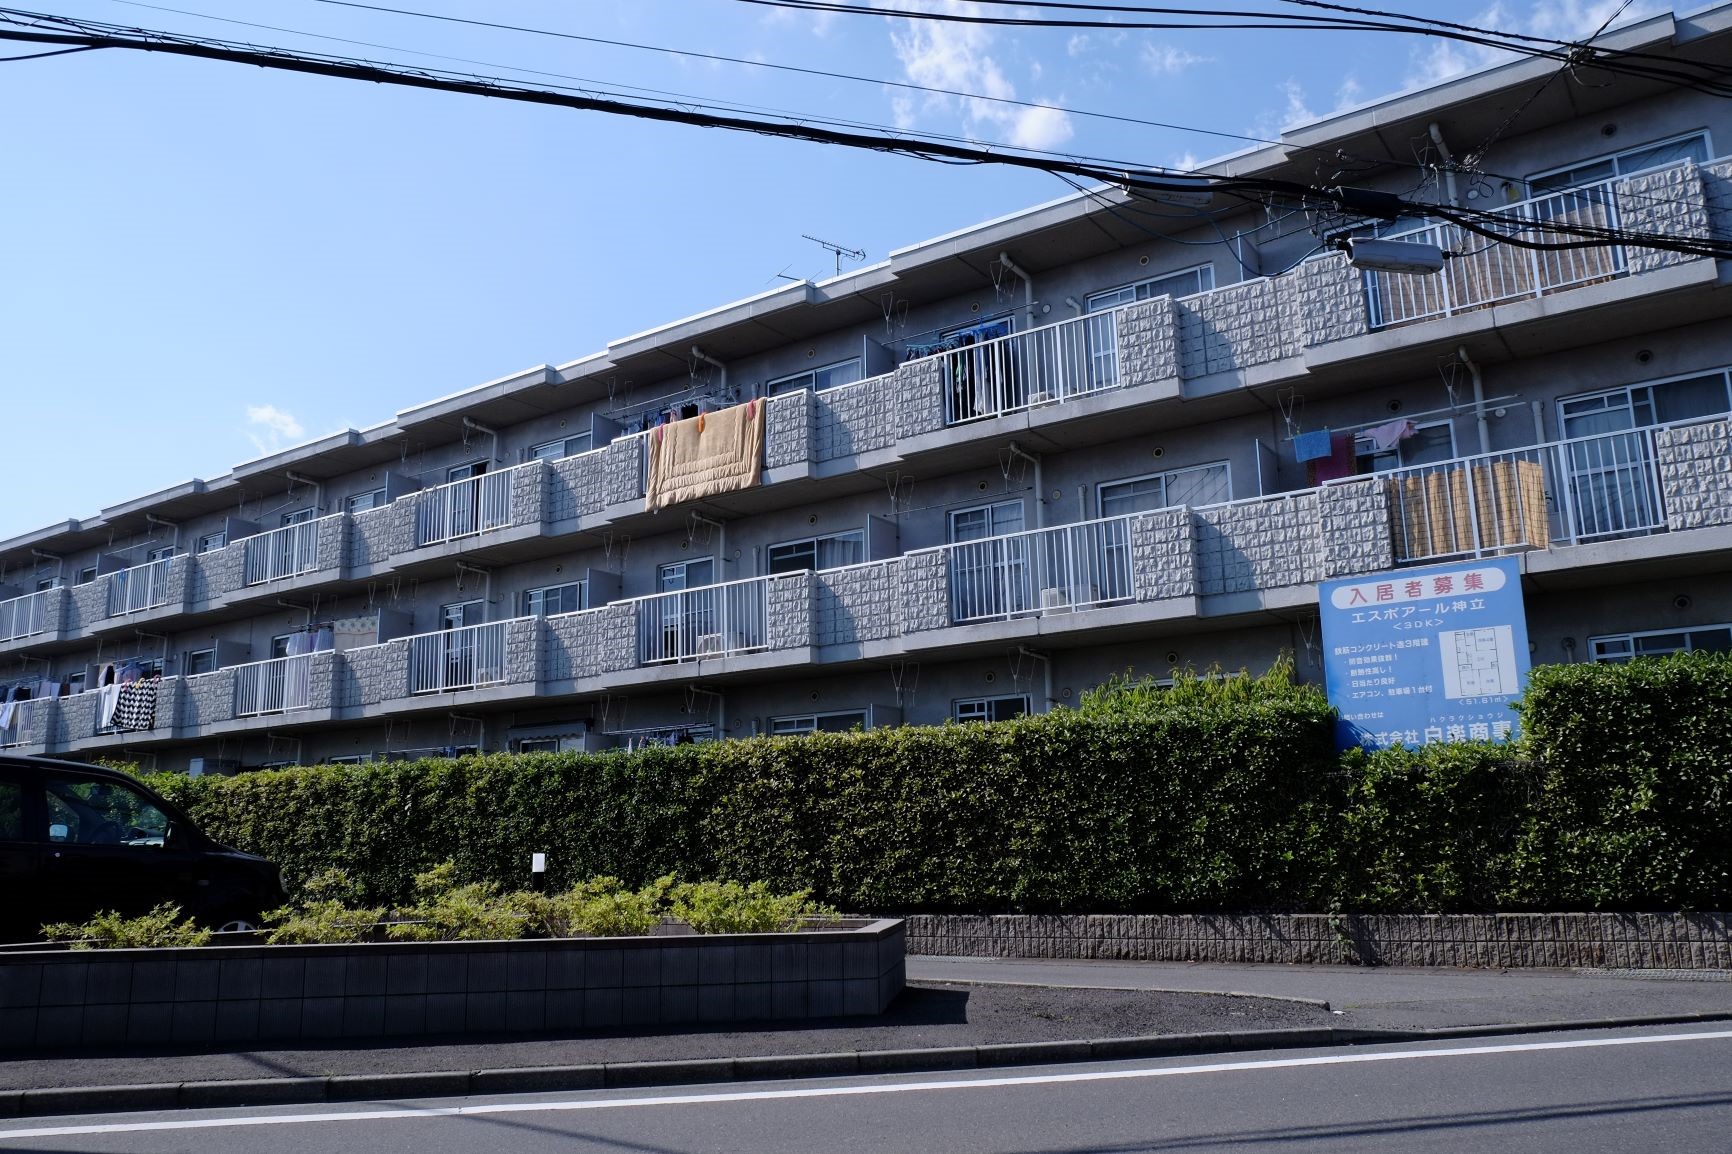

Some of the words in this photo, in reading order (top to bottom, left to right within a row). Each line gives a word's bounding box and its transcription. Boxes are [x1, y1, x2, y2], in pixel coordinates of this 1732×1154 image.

[1350, 572, 1484, 605] 入居者募集
